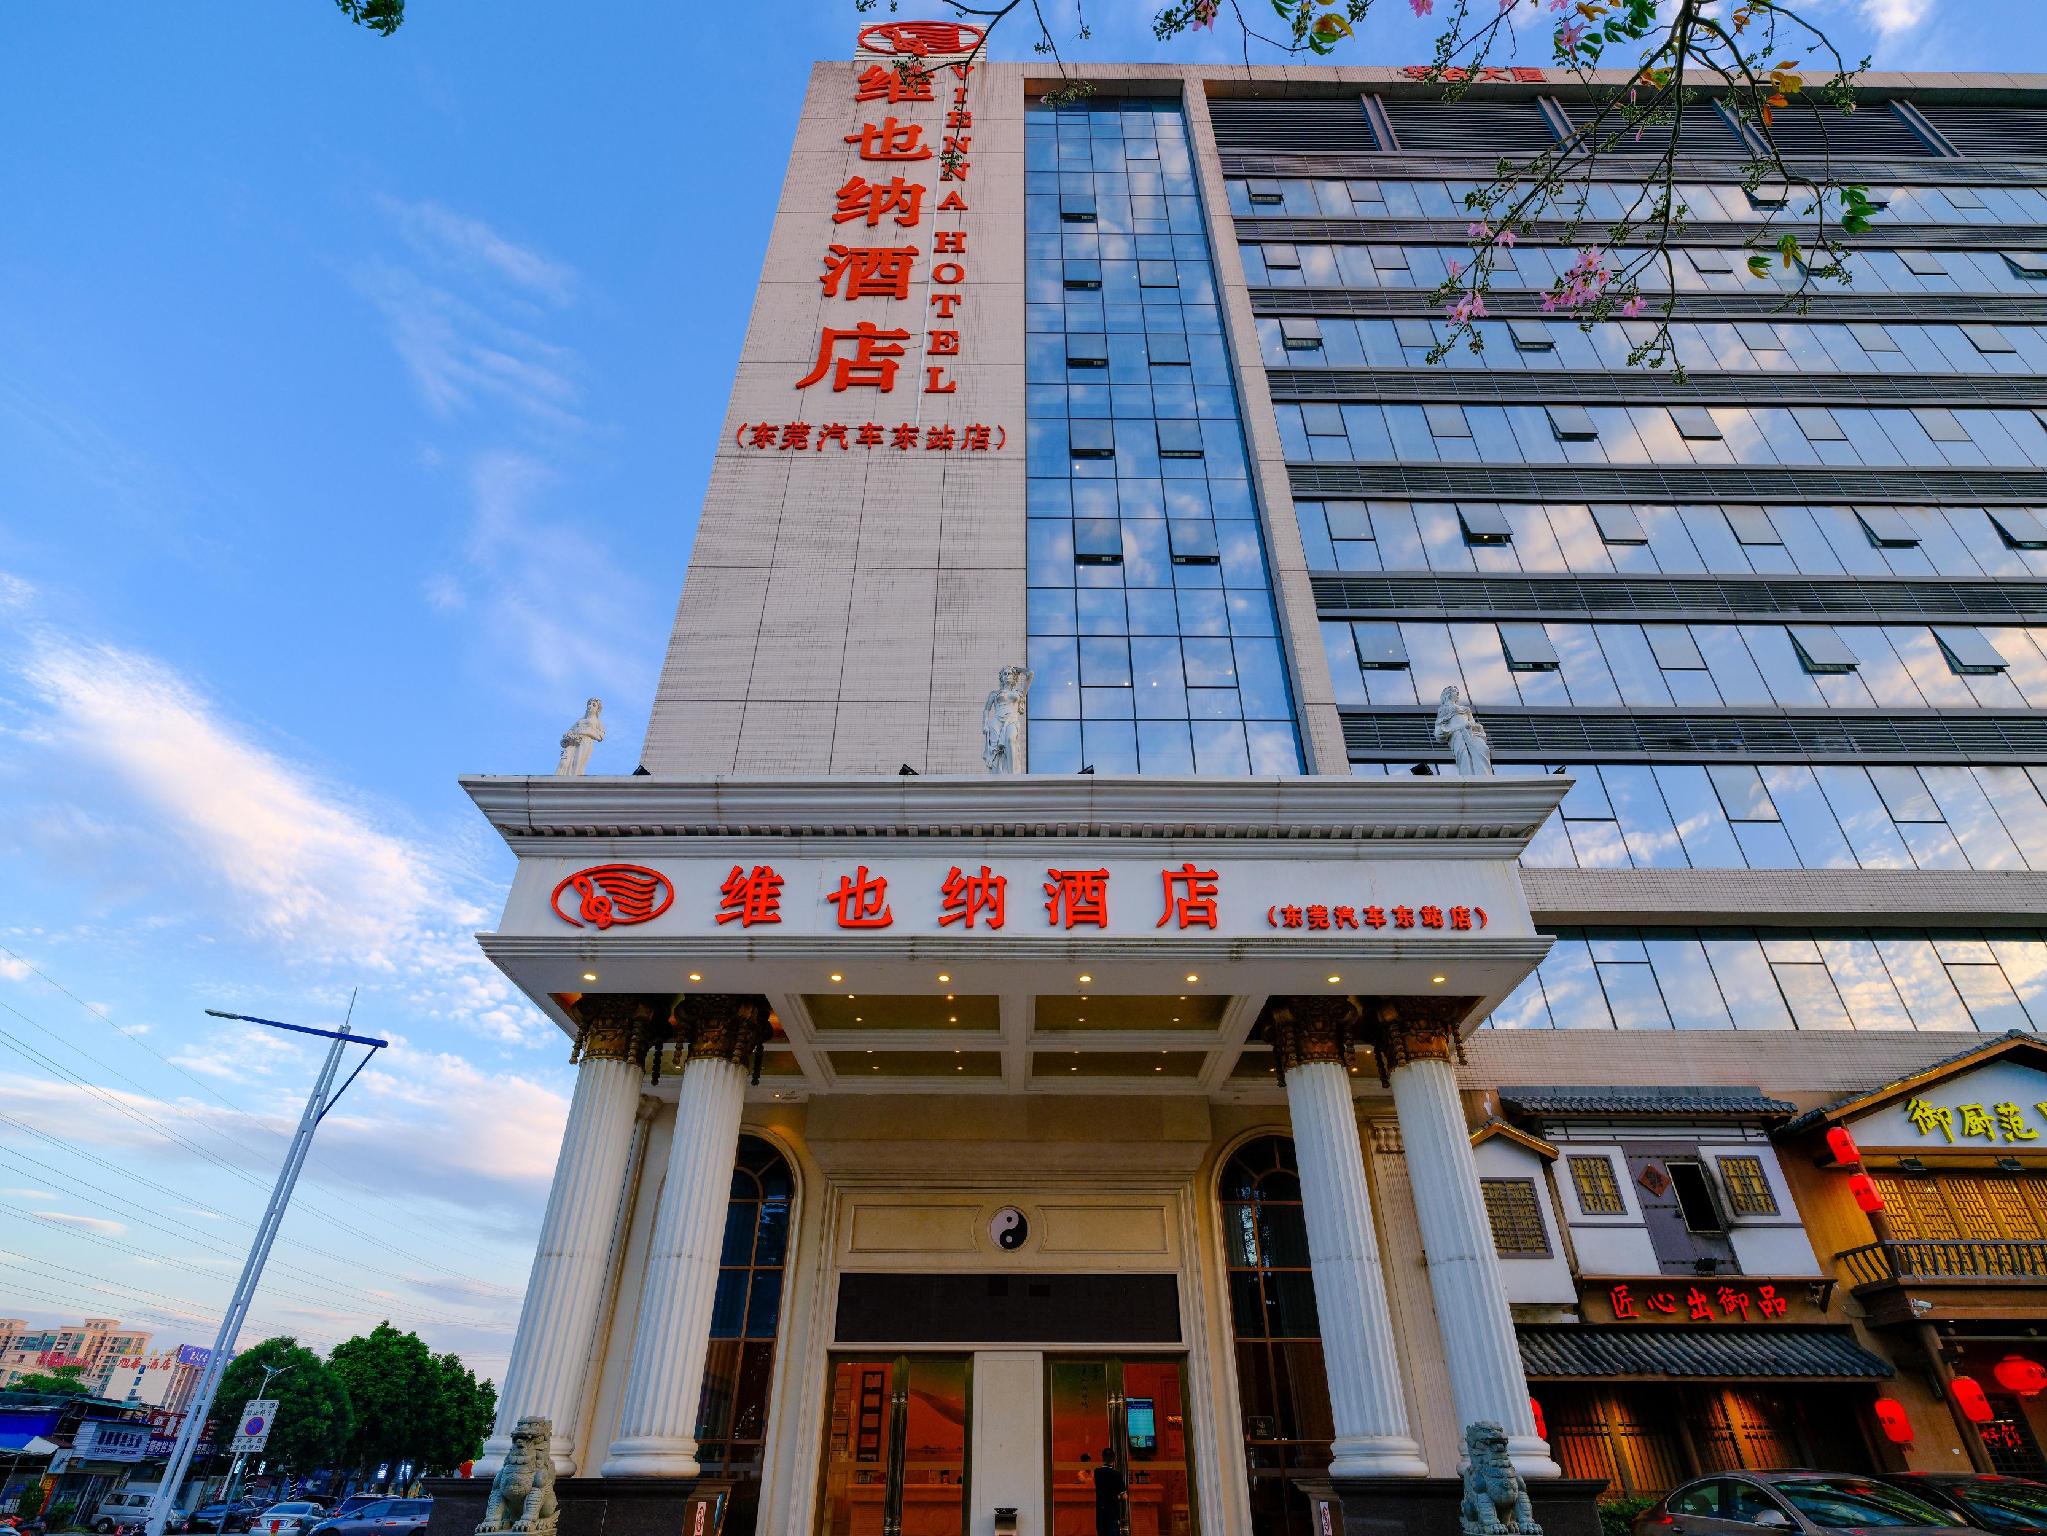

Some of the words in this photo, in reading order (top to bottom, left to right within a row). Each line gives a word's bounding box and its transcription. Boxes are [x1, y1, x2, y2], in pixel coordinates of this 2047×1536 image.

[937, 65, 975, 211] VIENNA
[795, 64, 935, 394] 维也纳酒店
[924, 231, 967, 394] HOTEL
[714, 863, 1220, 930] 维也纳酒店
[1610, 1284, 1787, 1322] 匠心出御品
